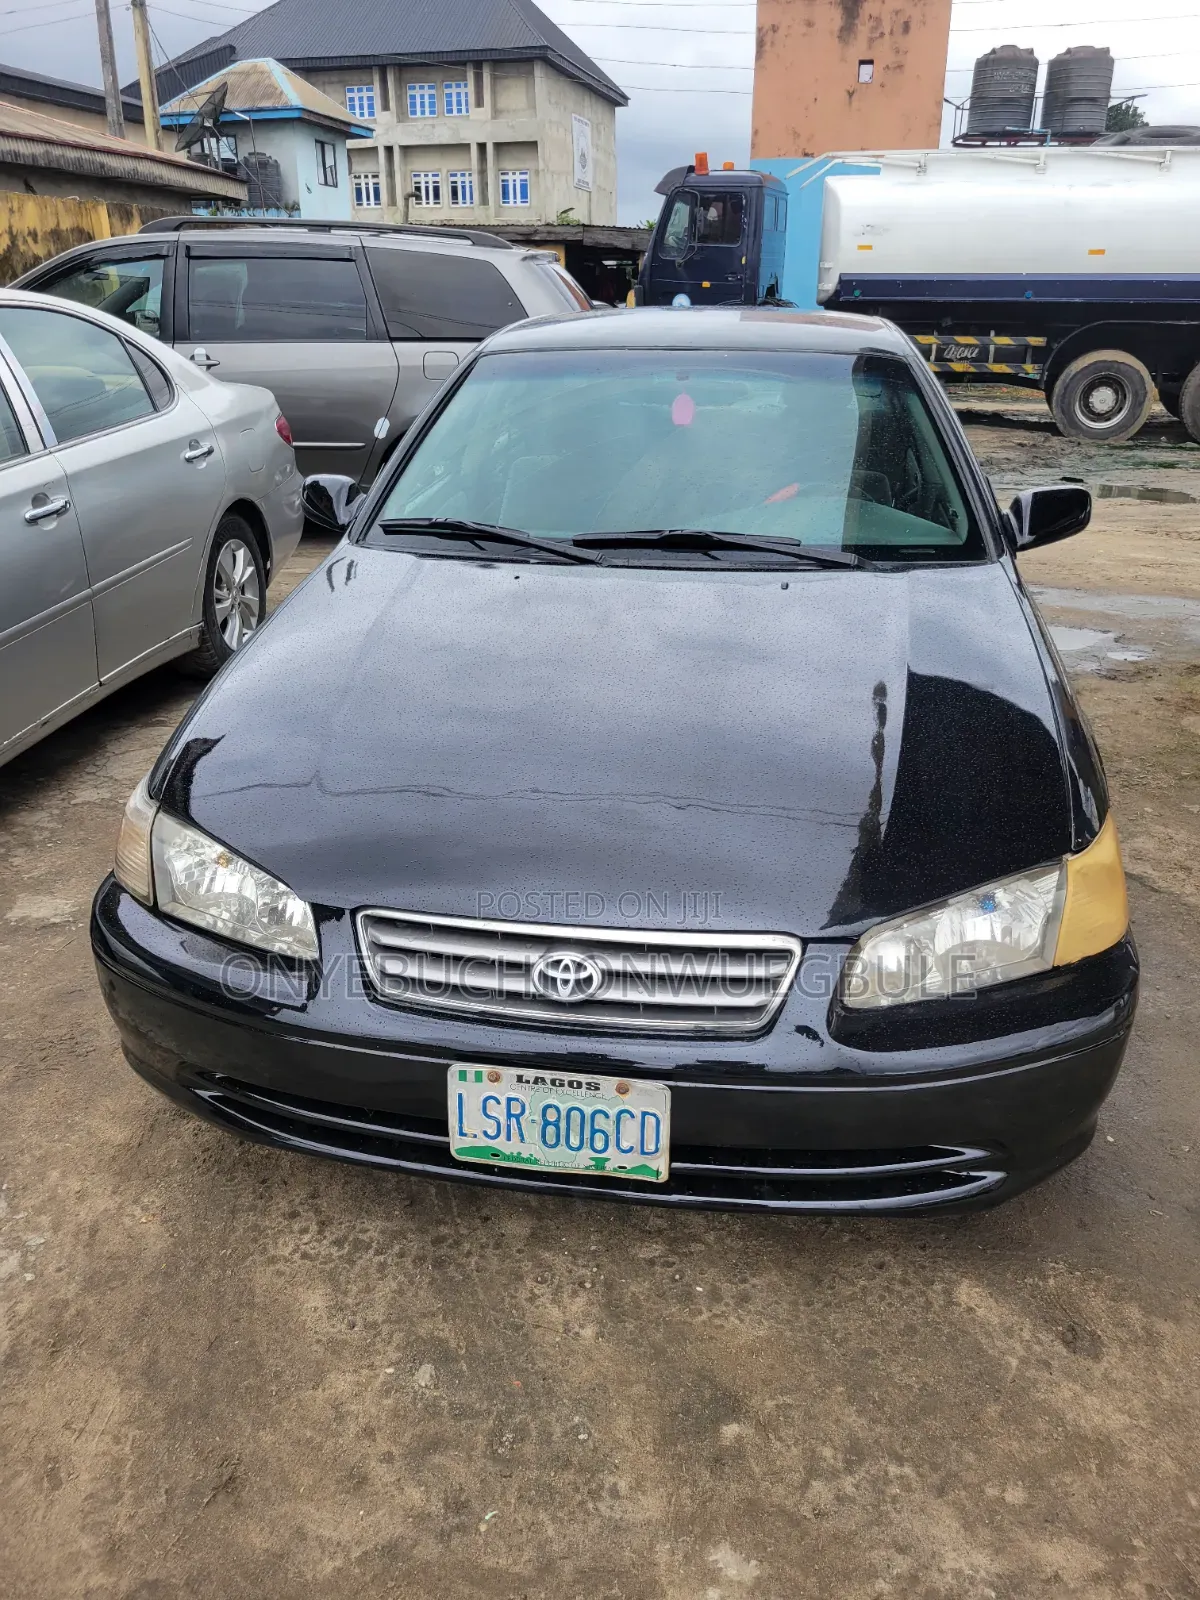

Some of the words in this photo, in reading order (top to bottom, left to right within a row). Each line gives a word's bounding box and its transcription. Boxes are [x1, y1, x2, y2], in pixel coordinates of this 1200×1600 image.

[509, 1083, 540, 1094] CENTRE
[542, 1086, 554, 1095] OF
[555, 1087, 607, 1100] EXCELLENCE
[515, 1074, 601, 1092] LAGOS
